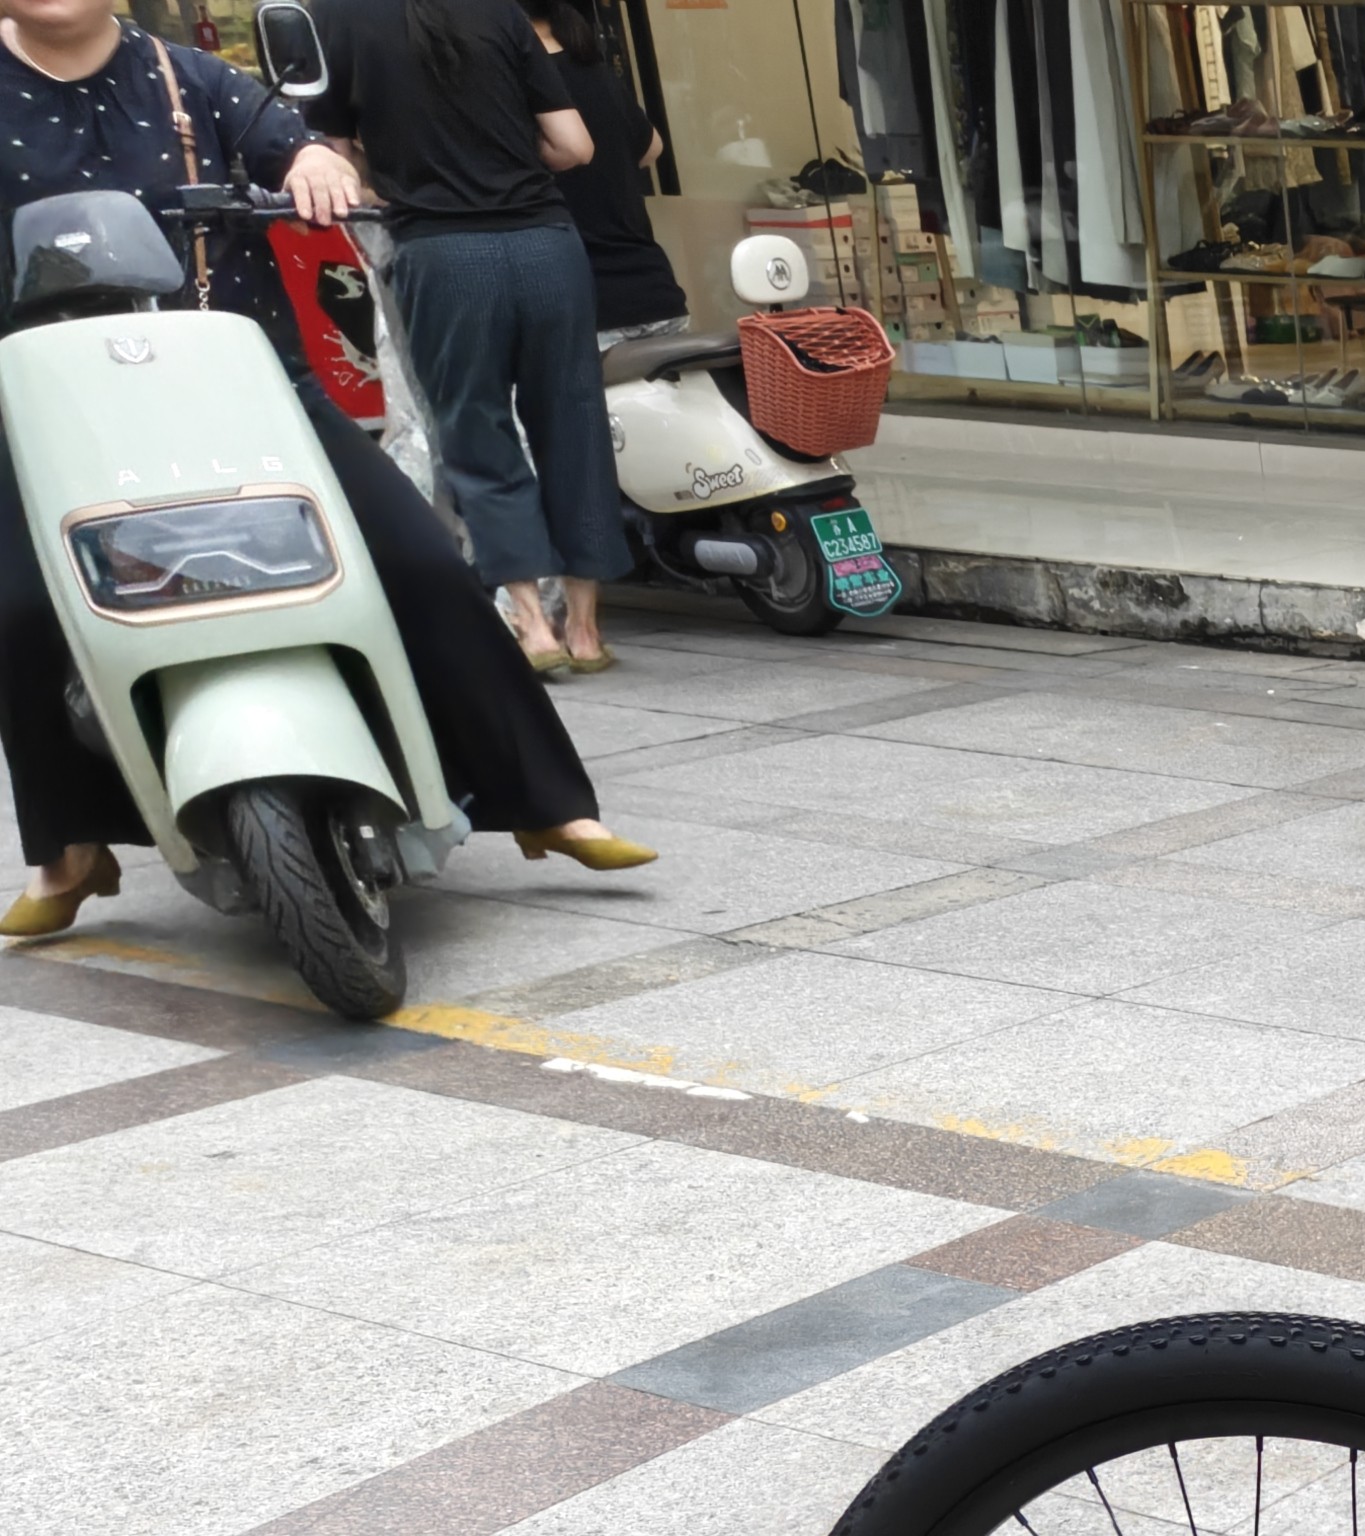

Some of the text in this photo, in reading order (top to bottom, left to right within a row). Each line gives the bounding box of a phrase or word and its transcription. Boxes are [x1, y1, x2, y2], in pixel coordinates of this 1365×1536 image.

[118, 456, 283, 486] AILG
[692, 463, 744, 500] Sweet
[823, 532, 877, 558] C234587
